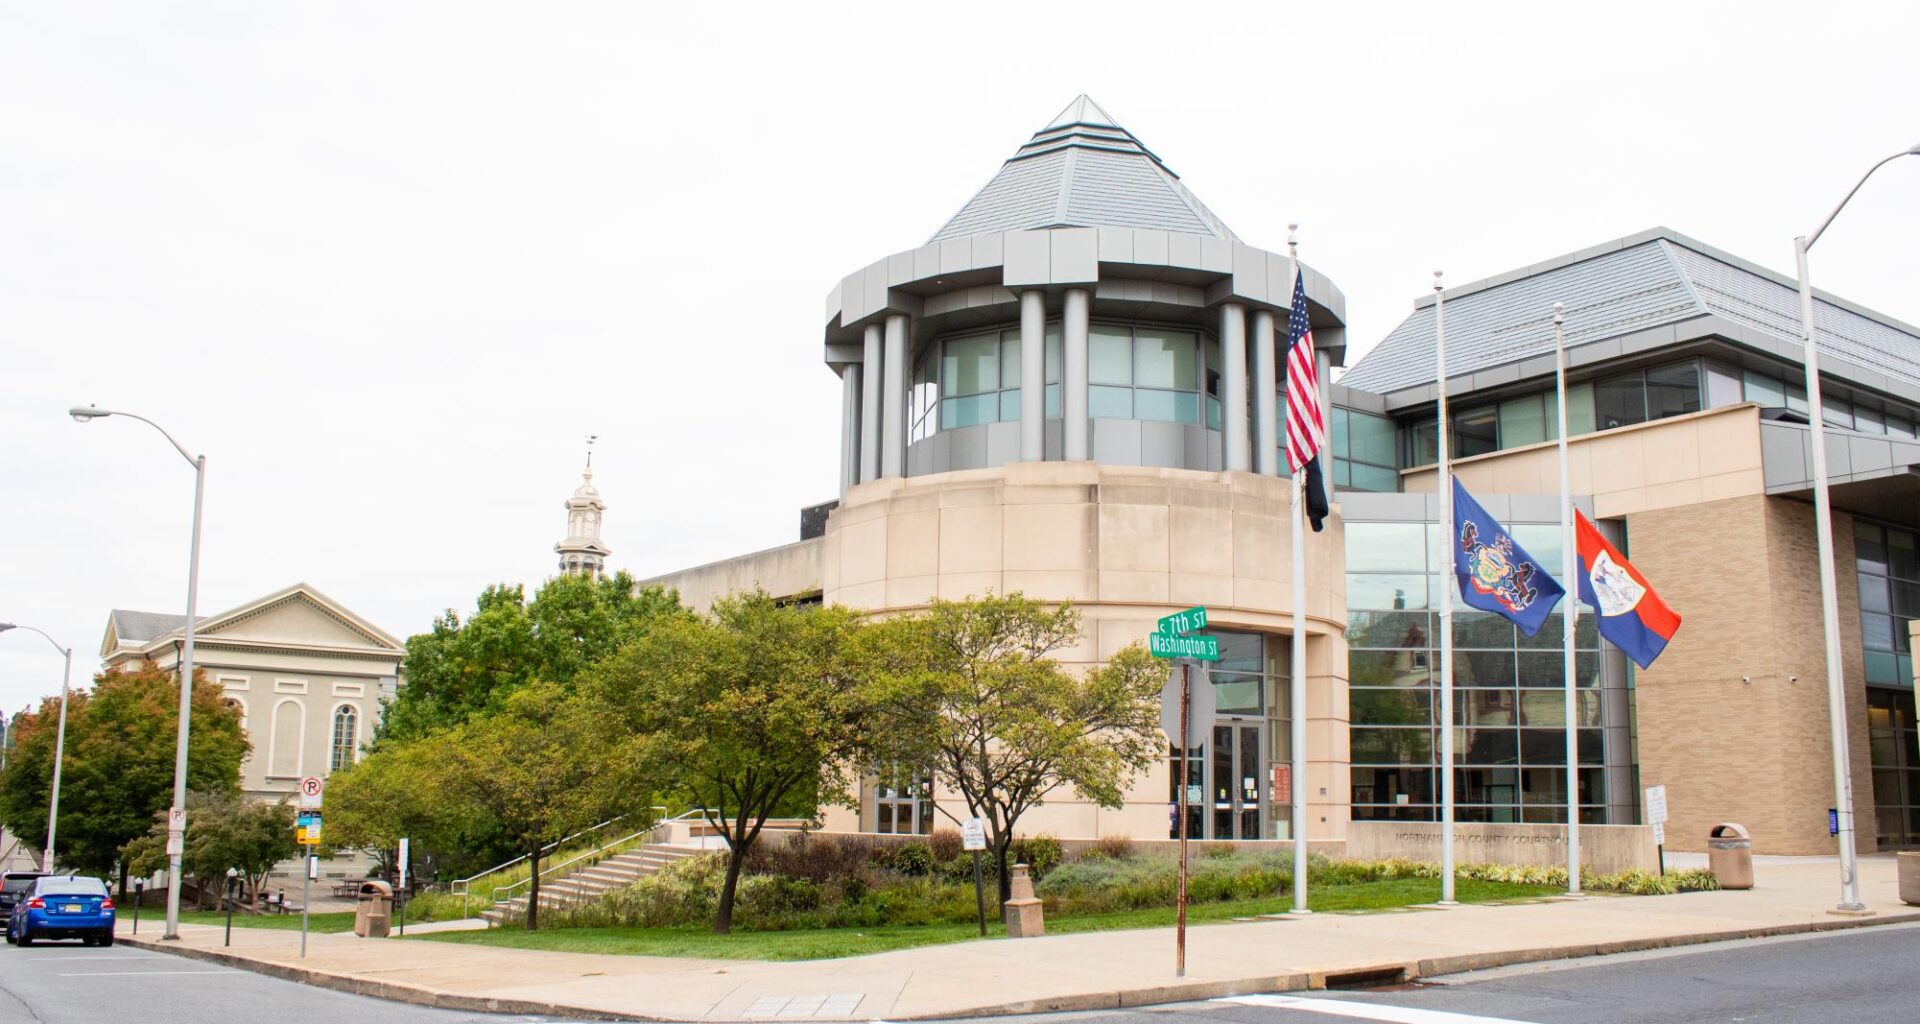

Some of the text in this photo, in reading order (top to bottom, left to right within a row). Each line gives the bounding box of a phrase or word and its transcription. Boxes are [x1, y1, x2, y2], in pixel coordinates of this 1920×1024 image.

[1159, 611, 1205, 635] S 7th ST
[1151, 634, 1217, 656] Washington ST
[1468, 834, 1509, 844] COUNTY
[1513, 835, 1582, 846] COURTHOUE
